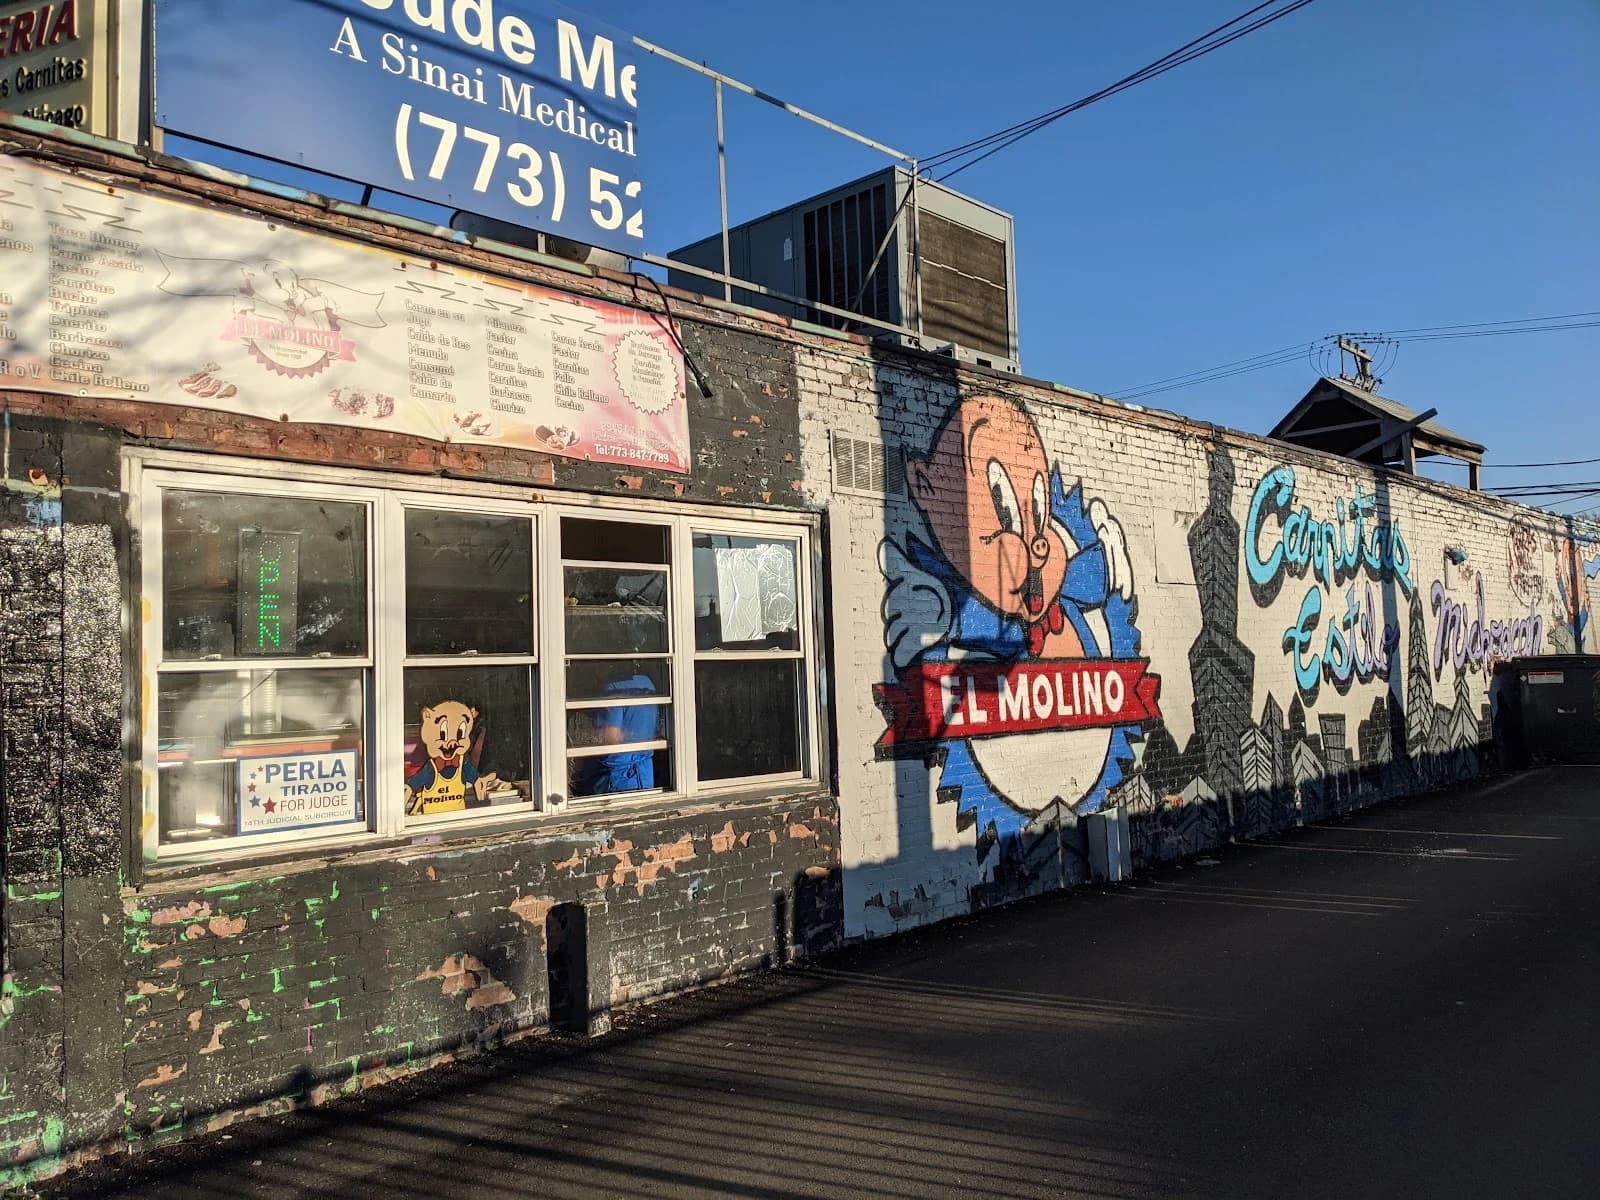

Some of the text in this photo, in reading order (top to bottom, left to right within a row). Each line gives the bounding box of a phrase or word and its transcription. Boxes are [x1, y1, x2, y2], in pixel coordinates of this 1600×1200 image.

[350, 0, 536, 65] ude
[15, 56, 87, 94] Carnitas
[329, 17, 638, 157] A Sinai Medical
[22, 103, 87, 127] icago
[395, 103, 565, 222] (773)
[1244, 463, 1413, 606] Carnitas
[259, 540, 282, 648] OPEN
[940, 669, 1125, 726] EL MOLINO
[265, 758, 347, 784] PERLA
[280, 781, 348, 797] TIRADO
[280, 794, 349, 813] FOR JUDGE
[423, 794, 463, 805] Molino
[437, 786, 450, 794] el
[265, 814, 302, 826] JUDICIAL
[304, 809, 353, 821] SUBCIRCUIT
